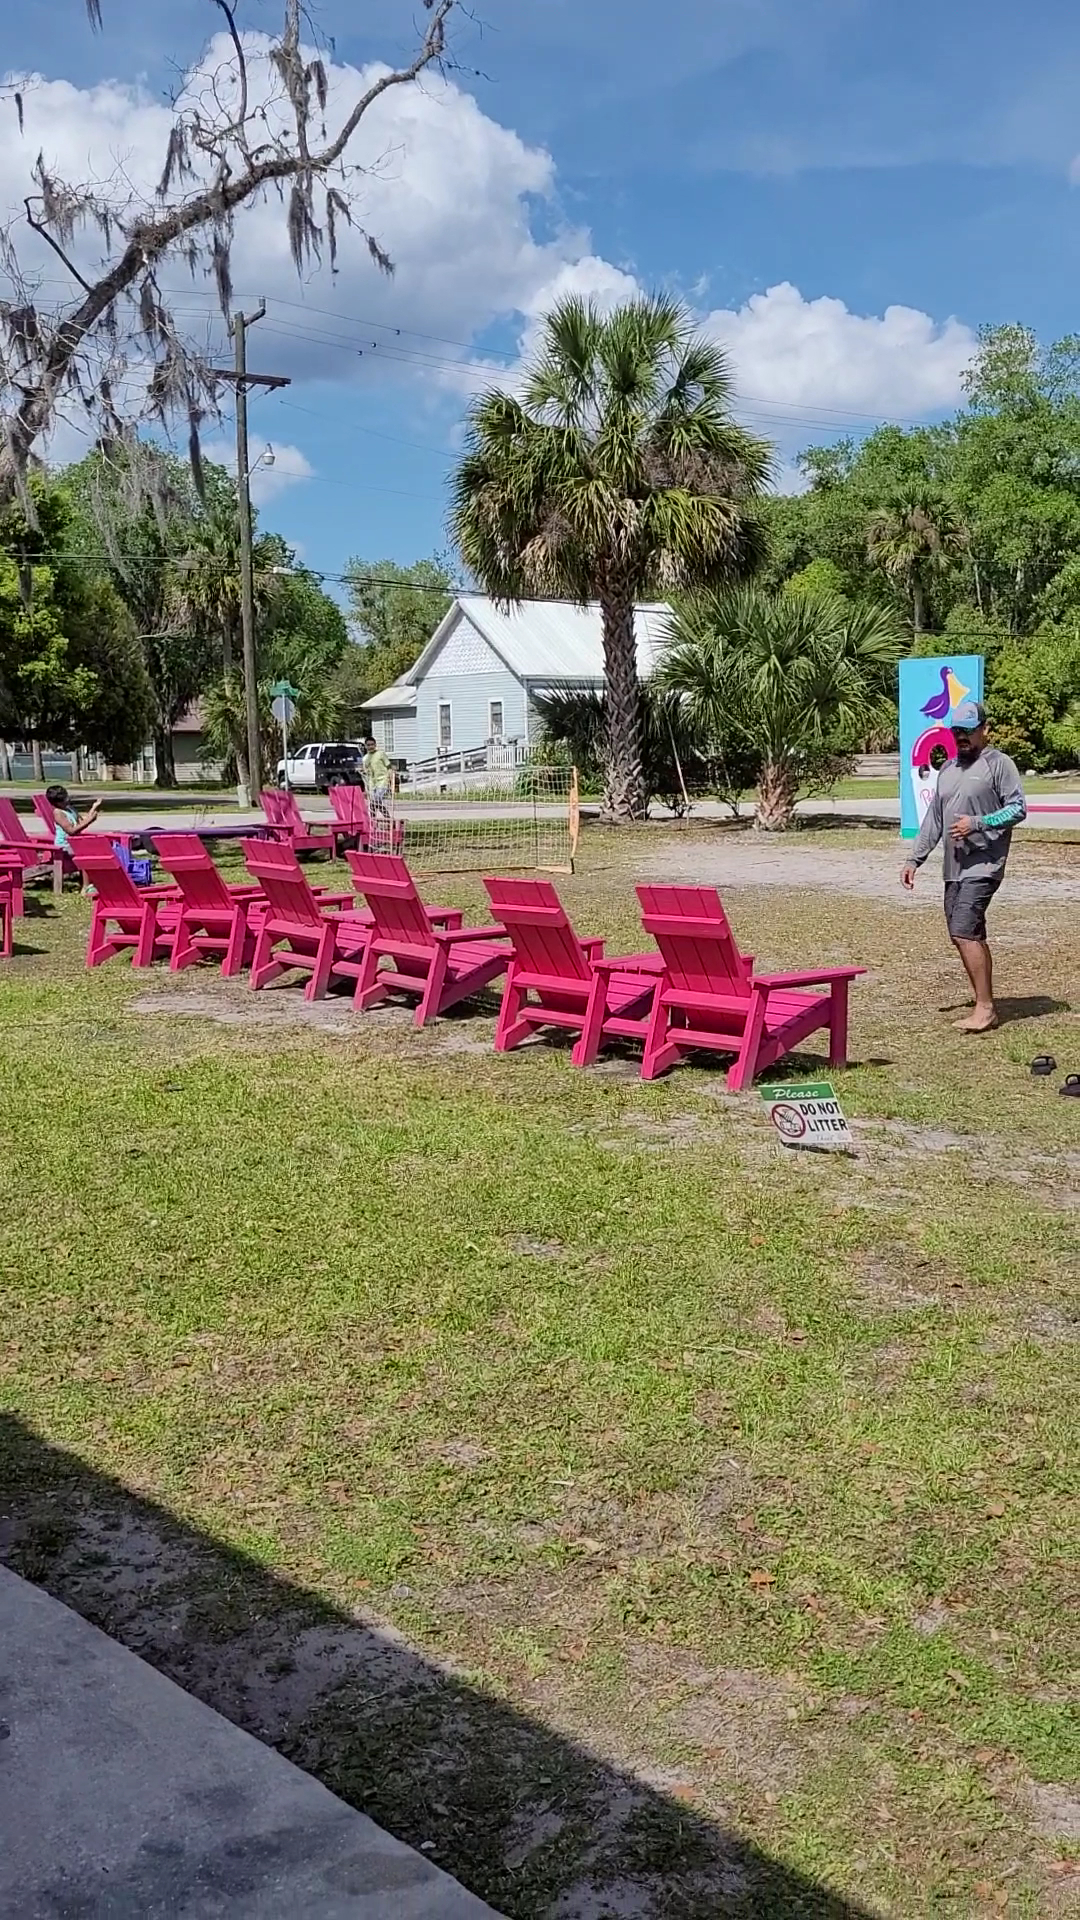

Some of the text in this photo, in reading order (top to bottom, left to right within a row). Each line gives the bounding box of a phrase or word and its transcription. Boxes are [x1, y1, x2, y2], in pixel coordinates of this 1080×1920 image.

[772, 1088, 819, 1099] Please
[799, 1101, 840, 1115] DO NOT
[807, 1118, 848, 1132] LITTER
